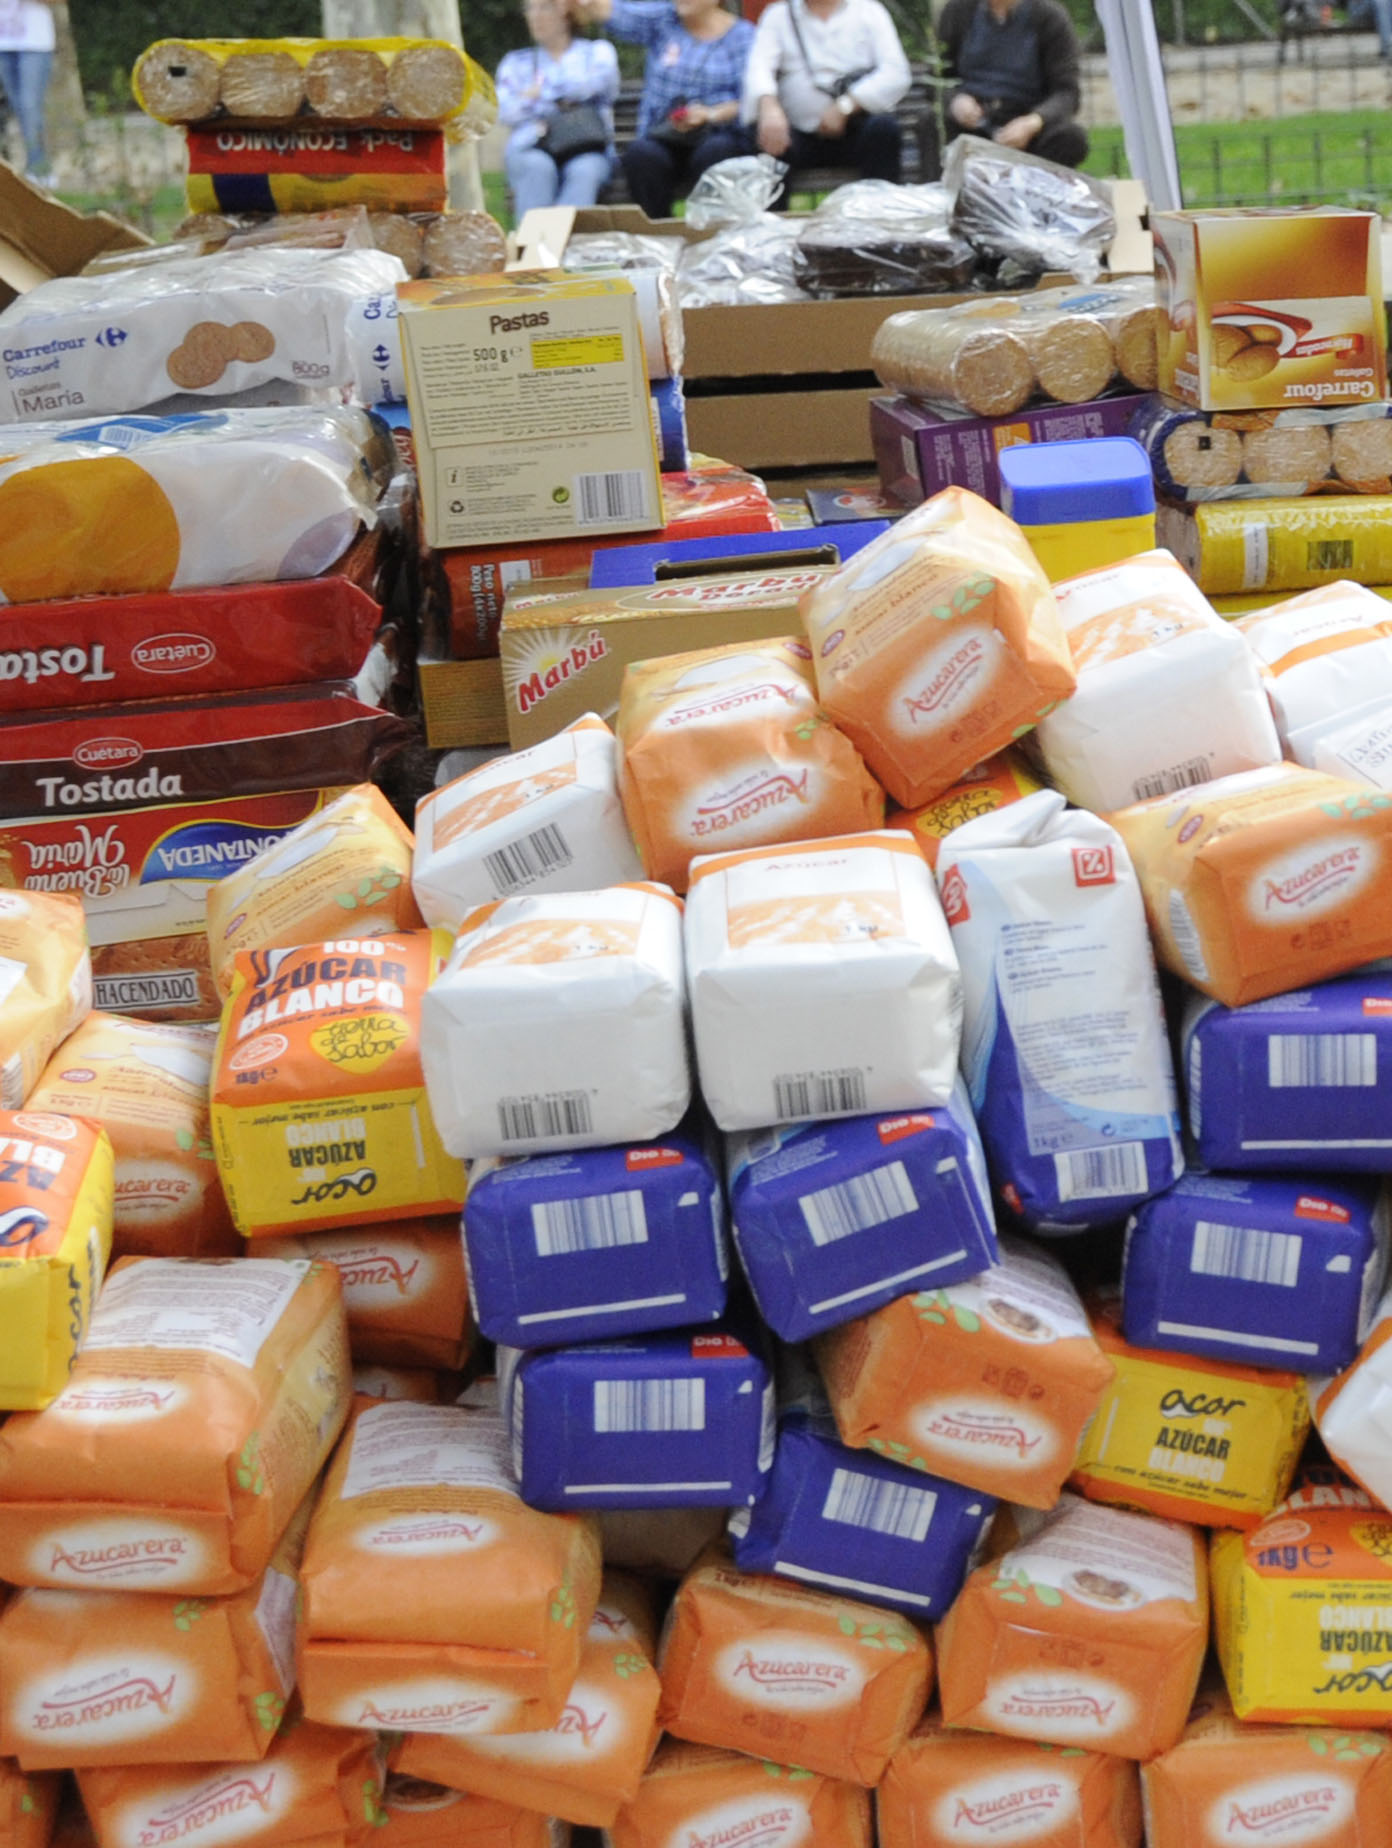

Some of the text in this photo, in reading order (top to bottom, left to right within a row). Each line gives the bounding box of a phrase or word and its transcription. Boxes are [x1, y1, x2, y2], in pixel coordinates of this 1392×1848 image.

[489, 311, 550, 334] Pastas
[2, 336, 86, 362] Carrefour
[472, 347, 498, 362] 500
[6, 358, 60, 380] Discount
[1283, 381, 1375, 401] Carrefour
[516, 628, 608, 714] Marbú
[902, 635, 983, 724] Azucarera
[35, 767, 184, 807] Tostada
[690, 768, 809, 837] Azucarera
[1264, 846, 1360, 912] Azucarera
[96, 975, 196, 1005] HACENDADO
[243, 959, 407, 1019] AZÚCAR
[237, 978, 405, 1040] BLANCO
[284, 1117, 367, 1145] BLANCO
[288, 1140, 367, 1169] AZÚCAR
[114, 1175, 191, 1195] ucarera
[291, 1167, 377, 1206] acor
[1160, 1389, 1247, 1419] acor
[927, 1420, 1043, 1460] Azucarera
[1155, 1426, 1232, 1461] AZÚCAR
[51, 1537, 187, 1573] Azucarera
[732, 1651, 850, 1683] Azucarera
[32, 1674, 176, 1731] Azucarera
[1000, 1699, 1115, 1725] Azucarera
[137, 1772, 276, 1848] Azucarera
[953, 1783, 1062, 1828] Azucarera
[1227, 1786, 1337, 1832] Azucarera
[686, 1807, 795, 1848] Azucarera
